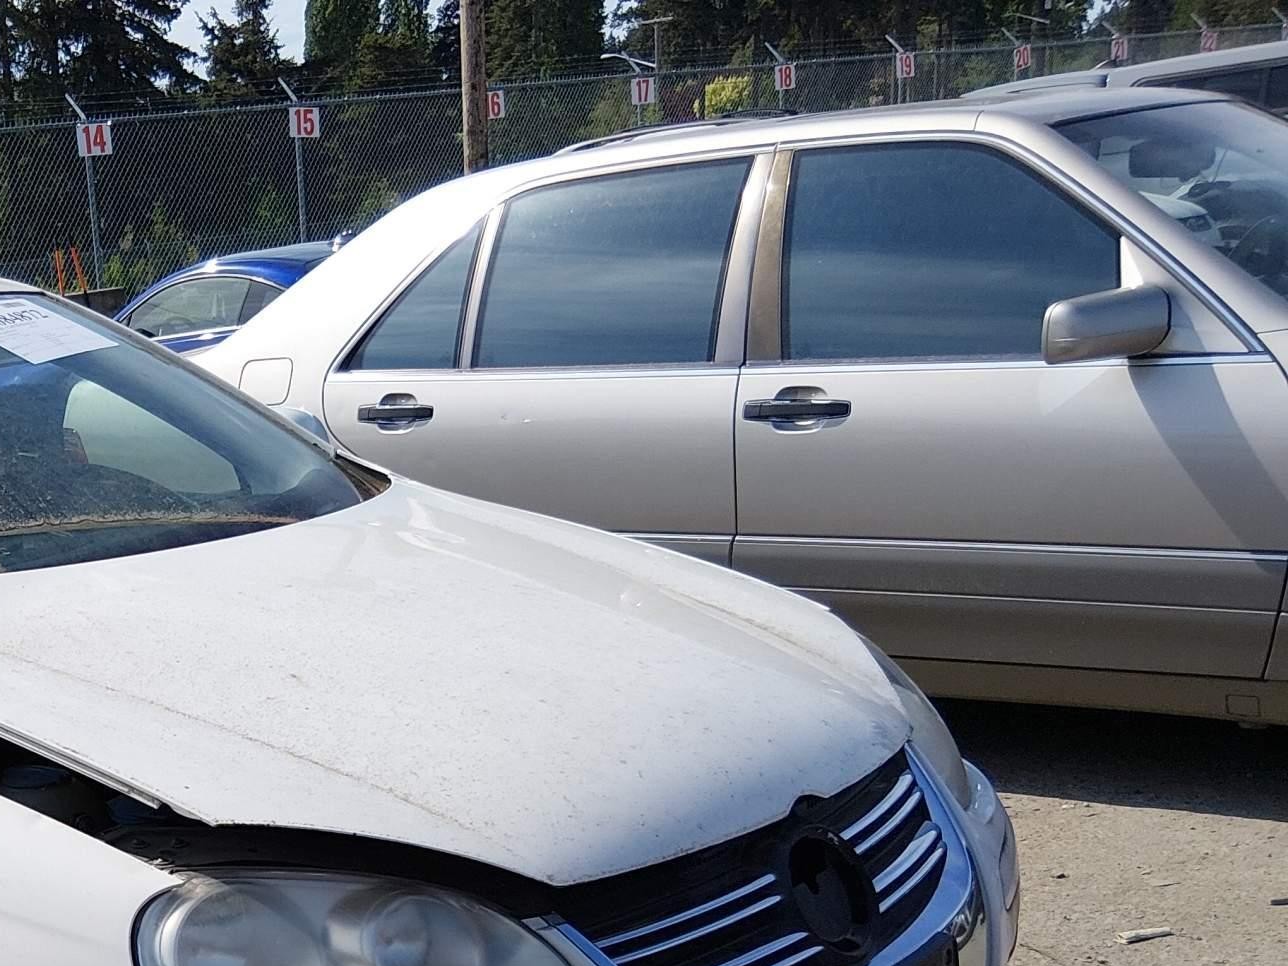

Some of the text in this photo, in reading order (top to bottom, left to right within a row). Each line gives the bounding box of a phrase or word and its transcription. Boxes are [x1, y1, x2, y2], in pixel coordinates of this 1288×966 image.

[1015, 47, 1031, 68] 20
[1114, 40, 1125, 60] 21
[898, 55, 912, 76] 19
[778, 66, 792, 88] 18
[636, 79, 650, 103] 17
[294, 108, 315, 136] 15
[82, 124, 107, 154] 14
